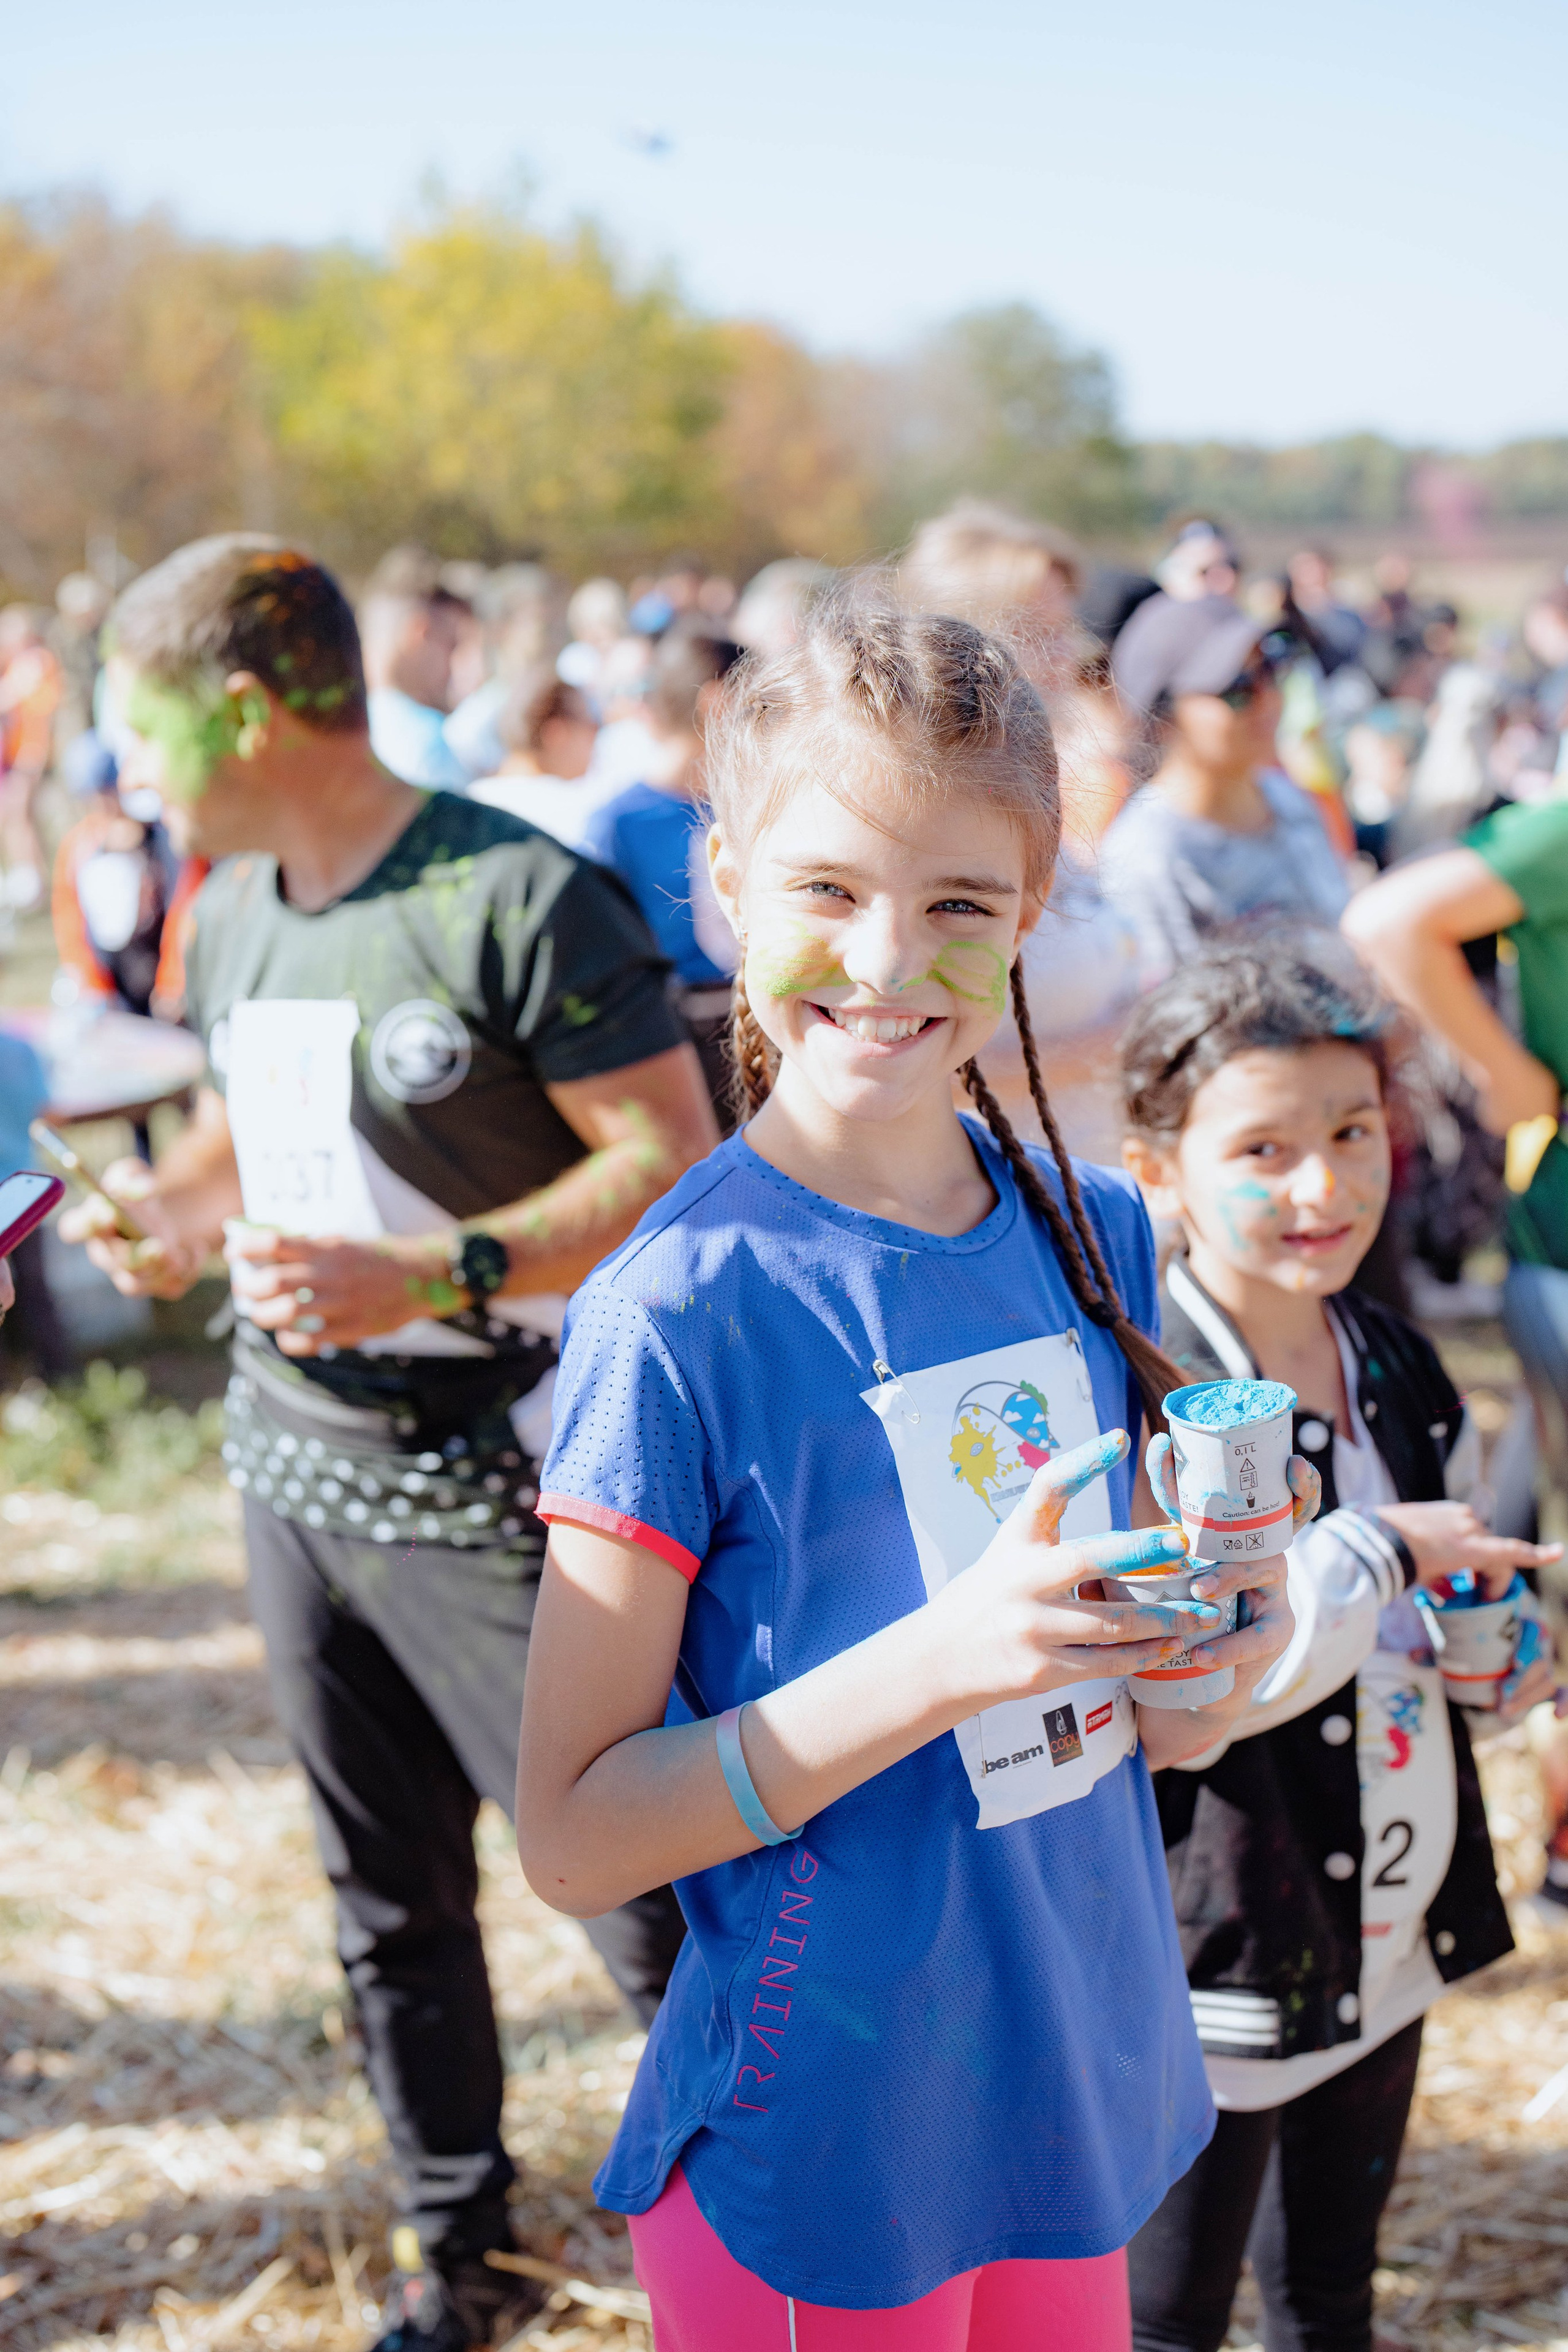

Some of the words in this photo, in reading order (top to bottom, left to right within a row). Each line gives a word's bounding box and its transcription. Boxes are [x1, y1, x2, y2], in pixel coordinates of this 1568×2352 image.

[1235, 1447, 1247, 1456] 0,1
[1167, 1658, 1193, 1667] TAST
[1050, 1731, 1080, 1753] copy
[982, 1757, 1009, 1774] be
[1011, 1744, 1044, 1764] am
[1373, 1820, 1413, 1887] 2
